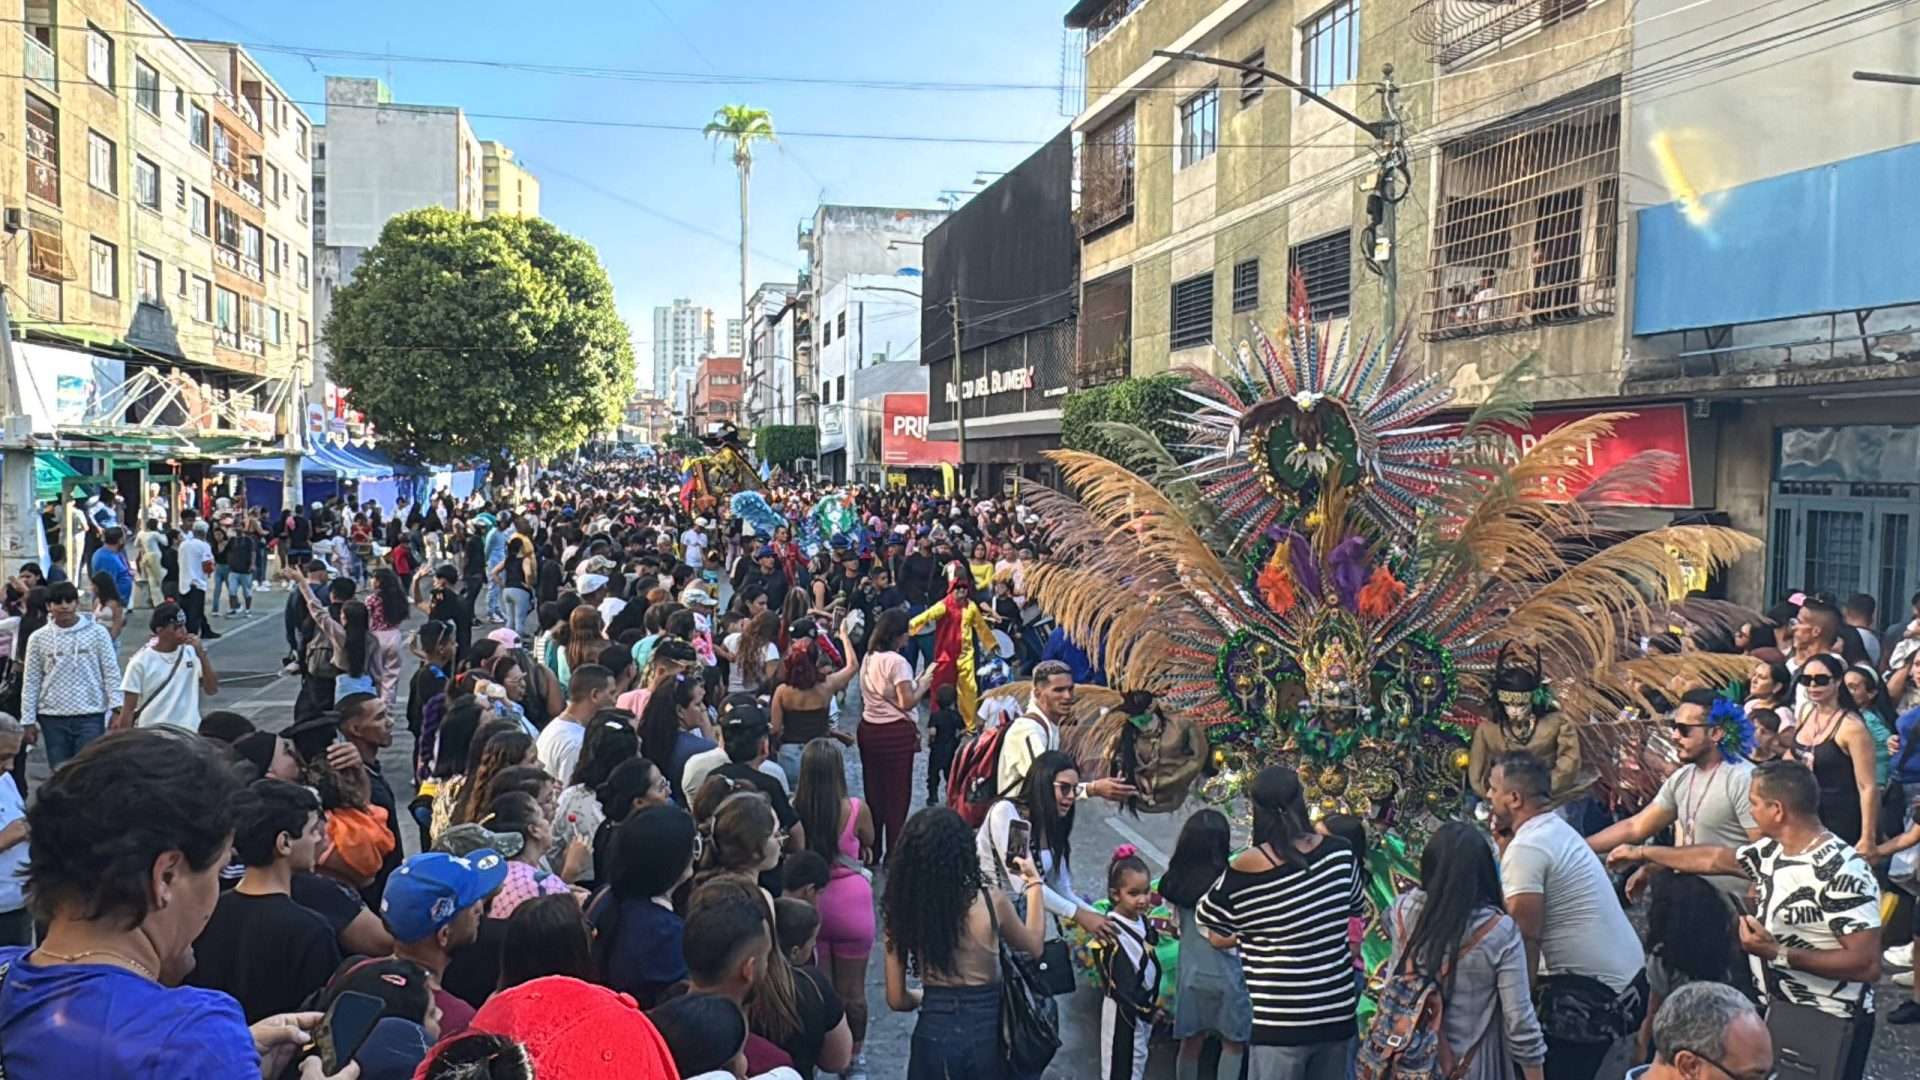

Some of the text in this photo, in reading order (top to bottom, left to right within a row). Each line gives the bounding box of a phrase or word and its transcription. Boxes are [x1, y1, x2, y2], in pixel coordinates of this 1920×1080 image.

[975, 376, 990, 397] DEL
[1827, 874, 1870, 896] NIKE
[1783, 905, 1825, 926] NIKE
